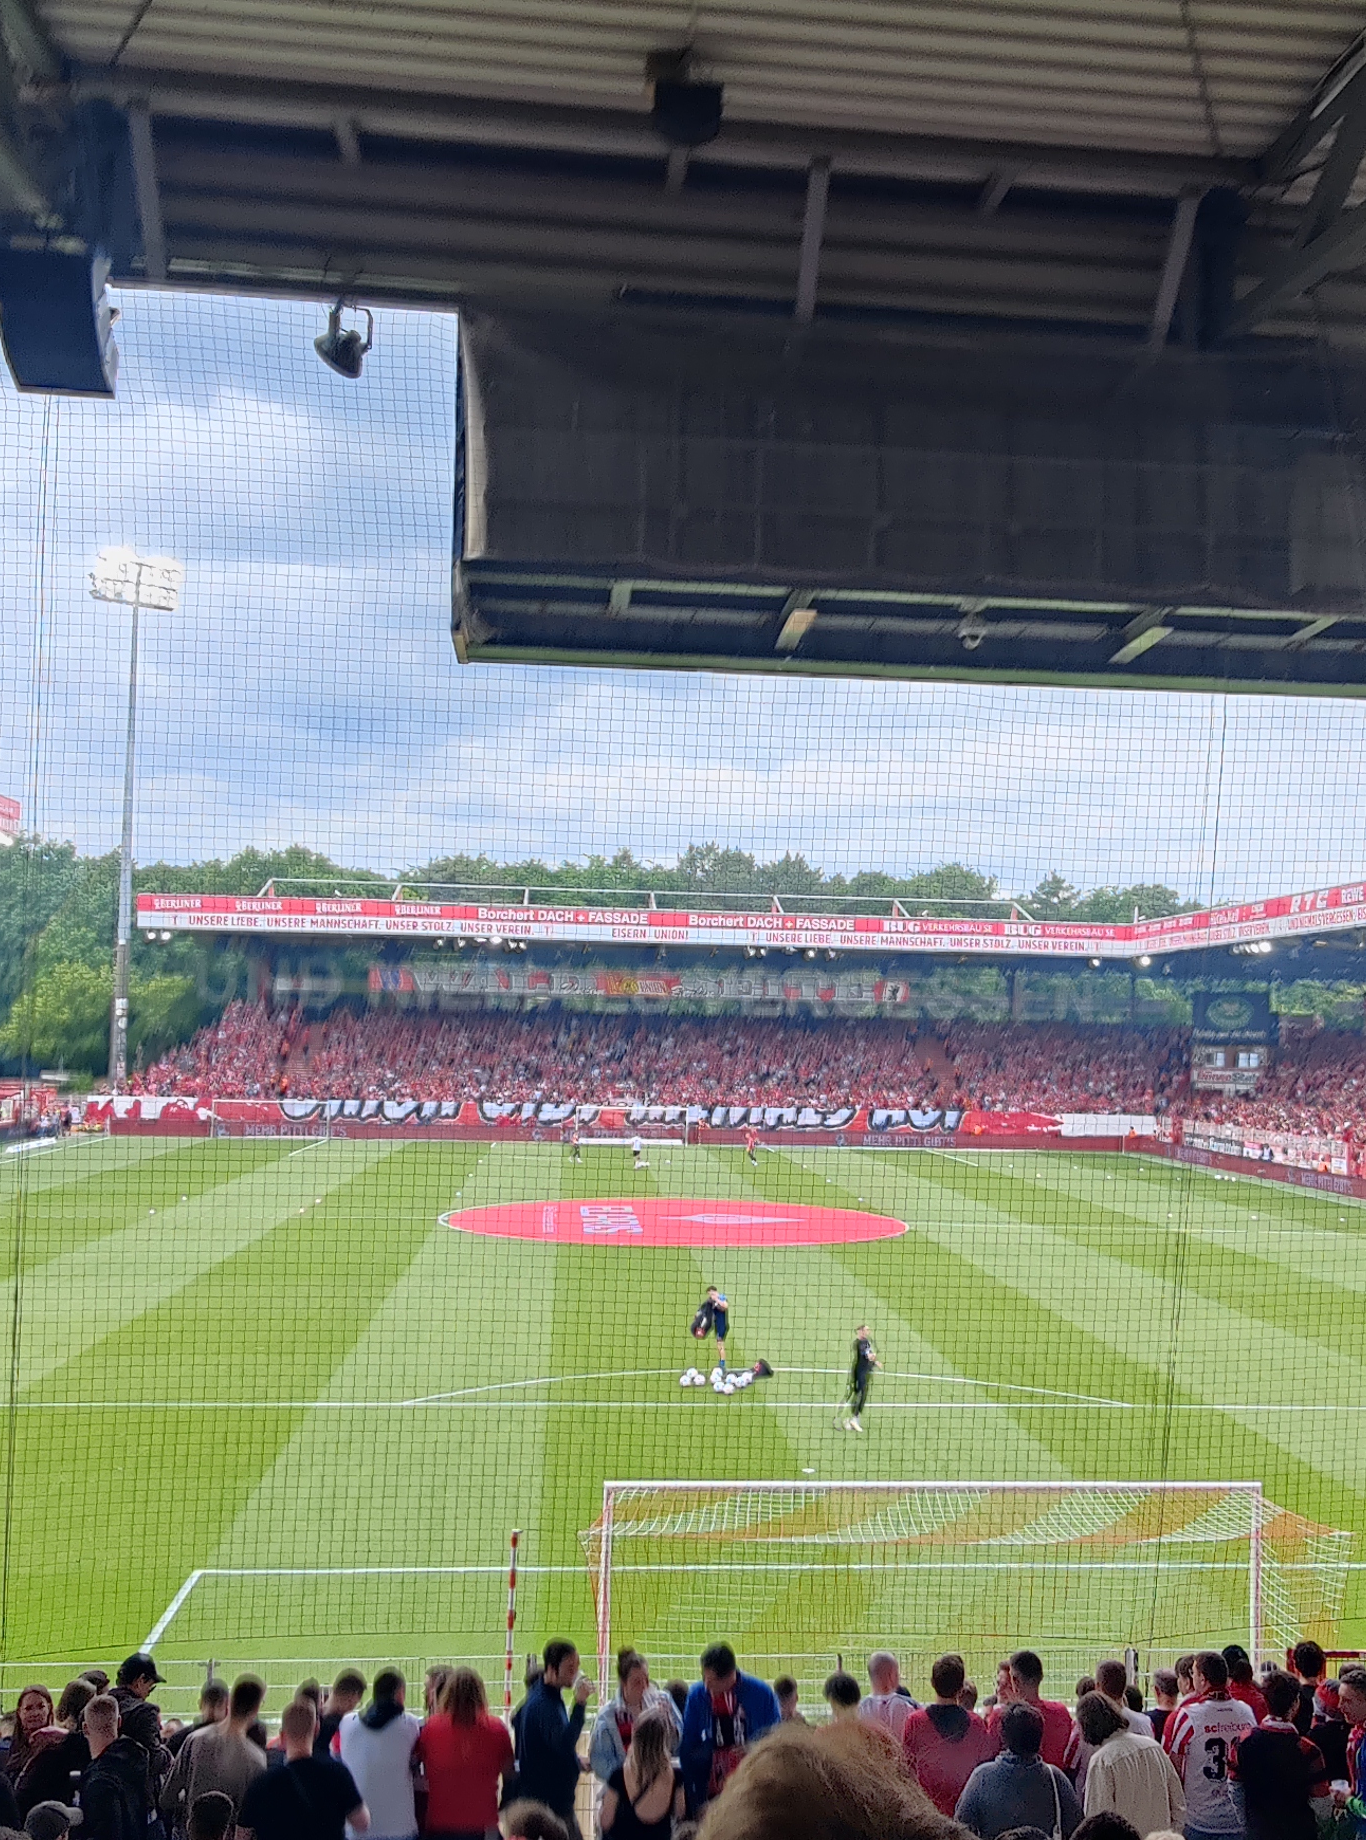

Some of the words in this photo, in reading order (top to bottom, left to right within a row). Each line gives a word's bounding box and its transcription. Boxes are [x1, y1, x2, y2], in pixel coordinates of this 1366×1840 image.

[160, 898, 202, 910] BERLINER
[242, 900, 282, 911] BERLINER
[322, 901, 362, 913] BERLINER
[401, 904, 441, 916] BERLINER
[478, 907, 535, 921] Borchert
[538, 910, 574, 922] DACH
[588, 912, 649, 925] FASSADE
[688, 914, 745, 927] Borchert
[747, 916, 783, 929] DACH
[796, 917, 855, 931] FASSADE
[188, 914, 229, 927] UNSERE
[231, 915, 263, 928] LIEBE.
[266, 917, 306, 929] UNSERE
[310, 918, 382, 931] MANNSCHAFT.
[385, 919, 419, 931] UNSER
[422, 920, 455, 932] STOLZ.
[460, 921, 494, 934] UNSER
[495, 923, 535, 936] VEREIN.
[885, 920, 921, 934] BUG
[1004, 923, 1042, 937] BUG
[611, 927, 647, 939] EISERN
[654, 928, 690, 941] UNION!
[765, 931, 803, 943] UNSERE
[804, 932, 834, 944] LIEBE.
[839, 934, 878, 946] UNSERE
[880, 935, 946, 948] MANNSCHAFT.
[949, 936, 981, 948] UNSER
[1018, 938, 1051, 951] UNSER
[1051, 939, 1089, 952] VEREIN.
